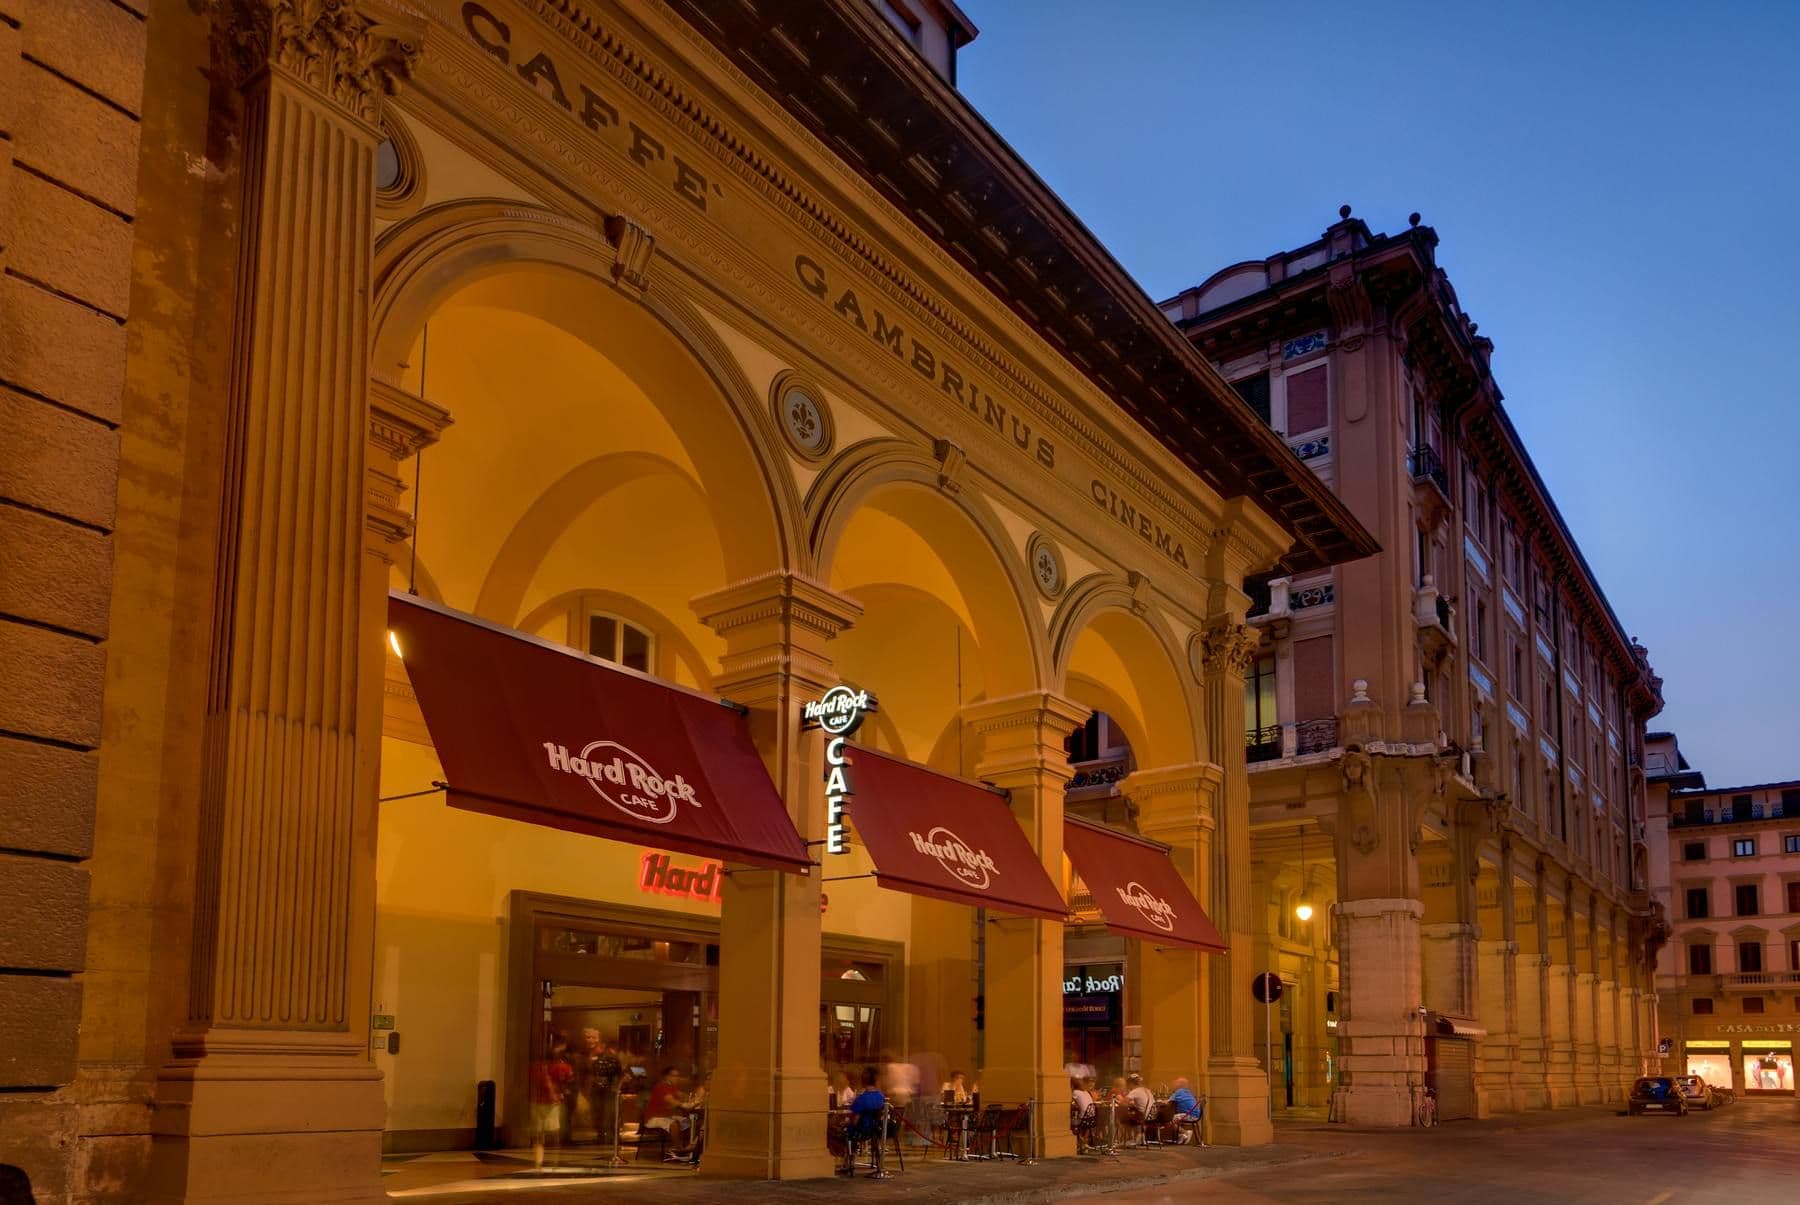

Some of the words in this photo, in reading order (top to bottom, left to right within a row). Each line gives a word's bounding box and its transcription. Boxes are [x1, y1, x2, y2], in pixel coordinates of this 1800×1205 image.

[795, 254, 1056, 470] GAMBRINUS
[1091, 479, 1189, 570] CINEMA
[804, 694, 838, 719] Hard
[836, 689, 868, 714] Rock
[829, 714, 849, 726] CAFE
[543, 742, 627, 786] Hard
[625, 762, 703, 808] Rock
[620, 793, 660, 811] CAFE
[825, 736, 848, 854] CAFE
[909, 831, 958, 862] Hard
[953, 842, 1001, 875] Rock
[641, 851, 718, 899] Hard
[956, 867, 980, 880] CAFE
[1116, 887, 1150, 910] Hard
[1717, 1024, 1752, 1033] CASA
